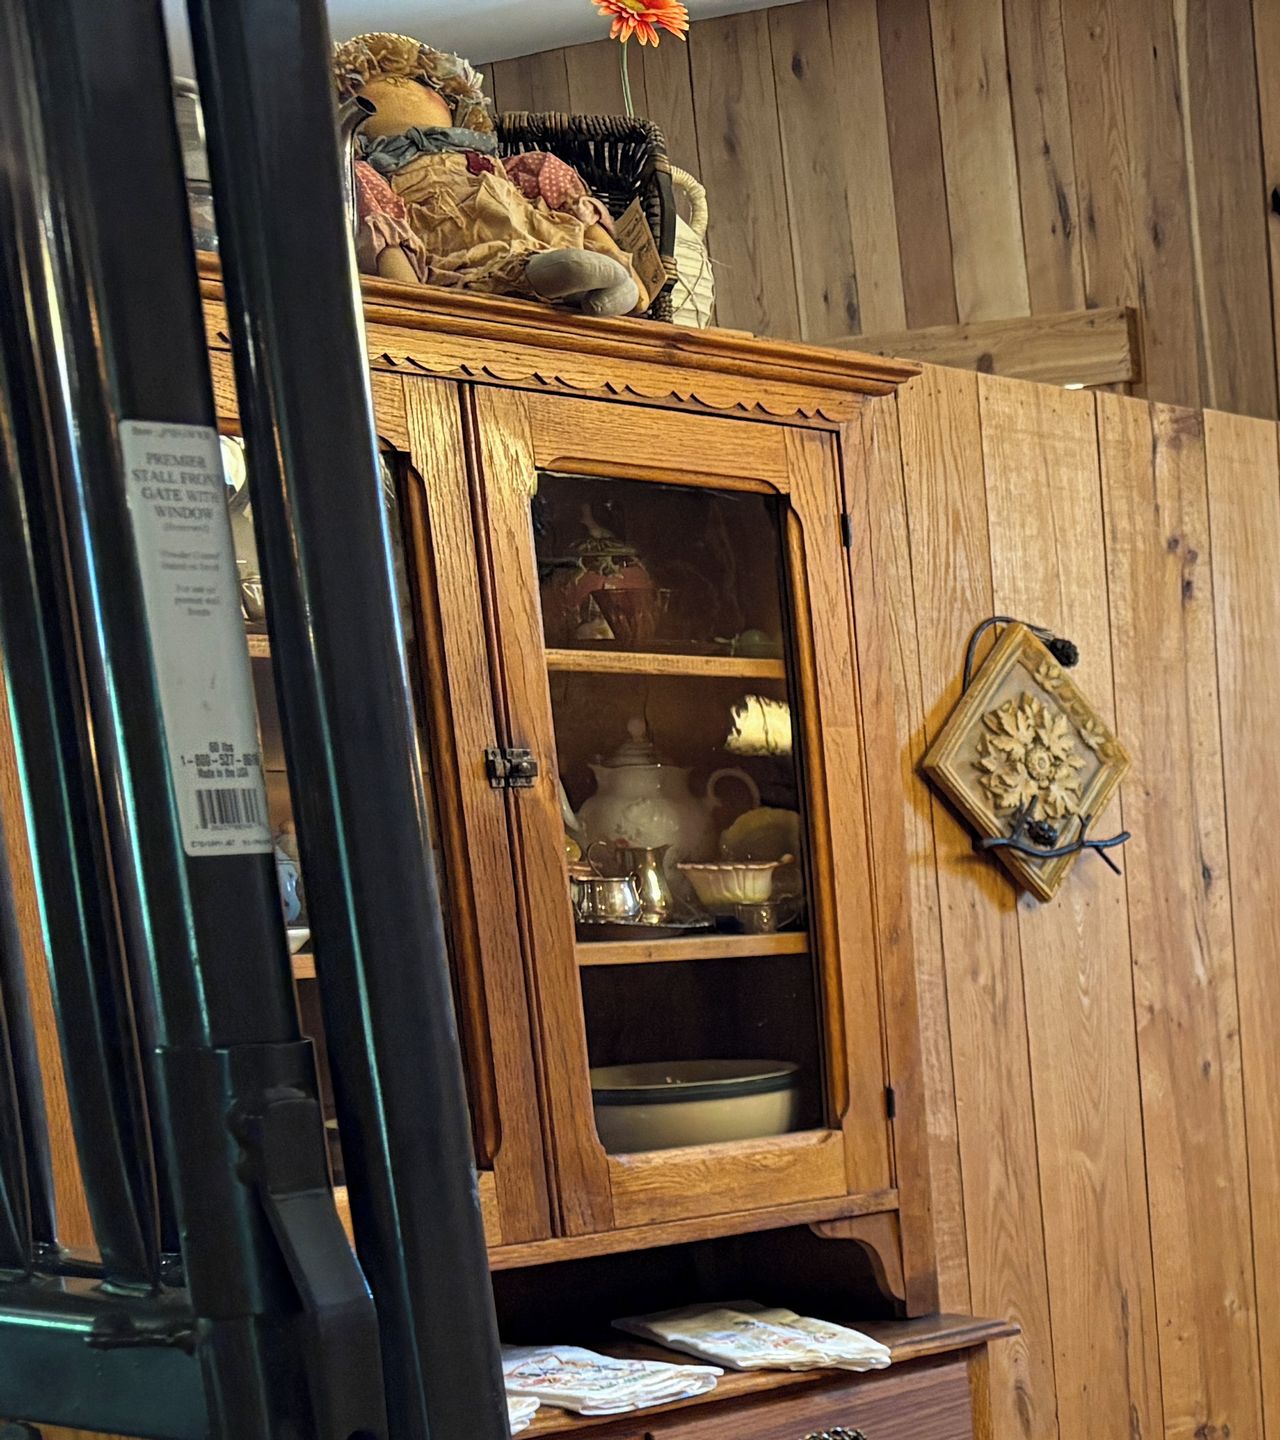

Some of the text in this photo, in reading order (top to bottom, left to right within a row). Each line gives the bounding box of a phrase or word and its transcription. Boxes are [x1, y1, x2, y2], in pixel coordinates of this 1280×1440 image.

[146, 452, 206, 468] PREMIER
[132, 470, 177, 483] STALL
[141, 487, 182, 500] GATE
[154, 505, 213, 518] WINDOW
